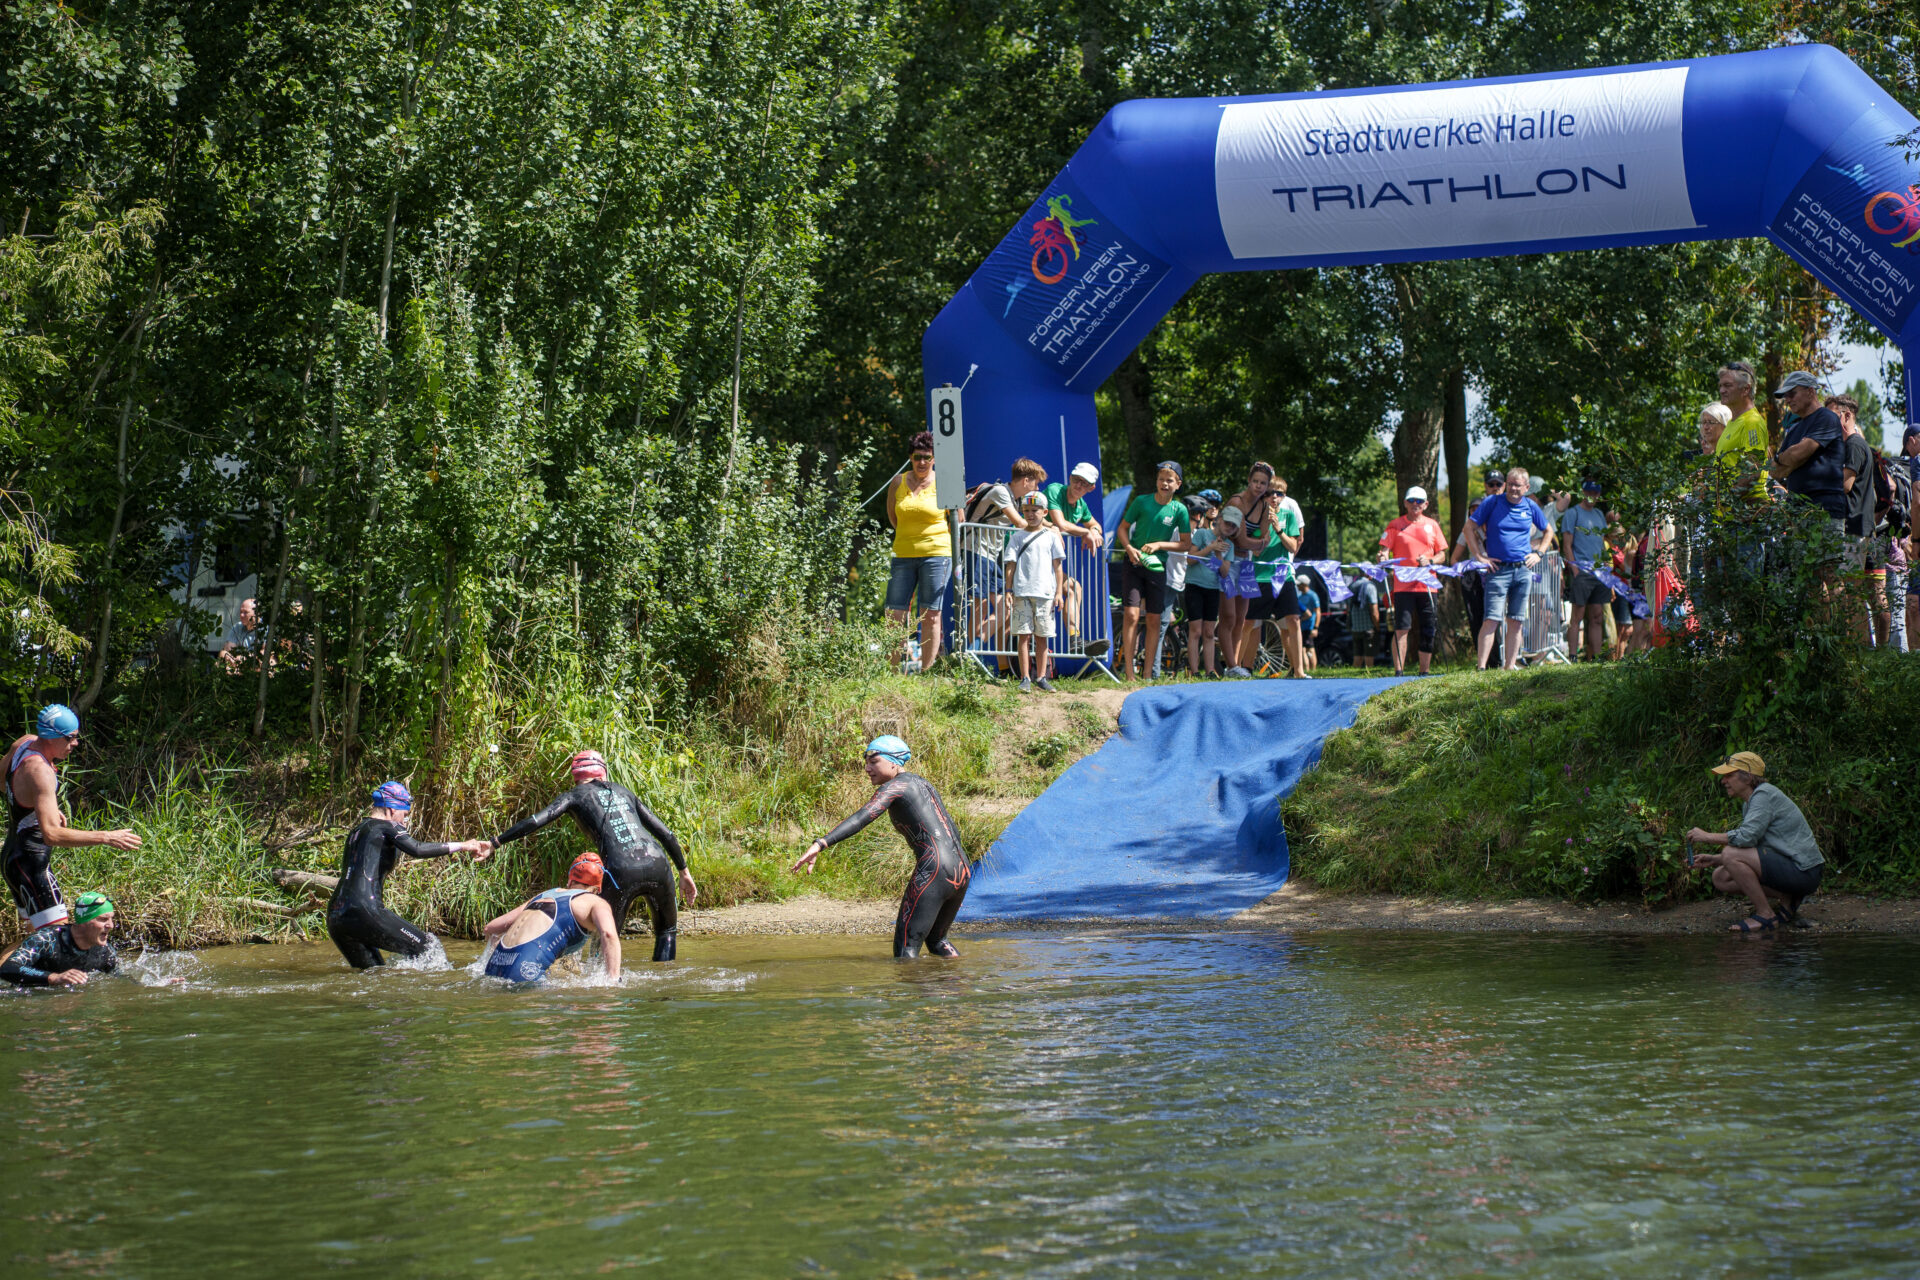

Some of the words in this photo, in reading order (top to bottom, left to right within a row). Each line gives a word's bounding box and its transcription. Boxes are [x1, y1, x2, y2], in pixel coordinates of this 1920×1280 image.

[1303, 117, 1483, 157] Stadtwerke
[1495, 109, 1576, 144] Halle
[1272, 163, 1627, 213] TRIATHLON
[1783, 221, 1896, 318] MITTELDEUTSCHLAND
[1793, 207, 1903, 306] TRIATHLON
[1798, 193, 1915, 293] FÖRDERVEREIN
[1028, 241, 1123, 346] FÖRDERVEREIN
[1042, 254, 1138, 355] TRIATHLON
[1058, 263, 1150, 365] MITTELDEUTSCHLAND
[938, 398, 955, 437] 8
[400, 927, 421, 944] VELOCITY
